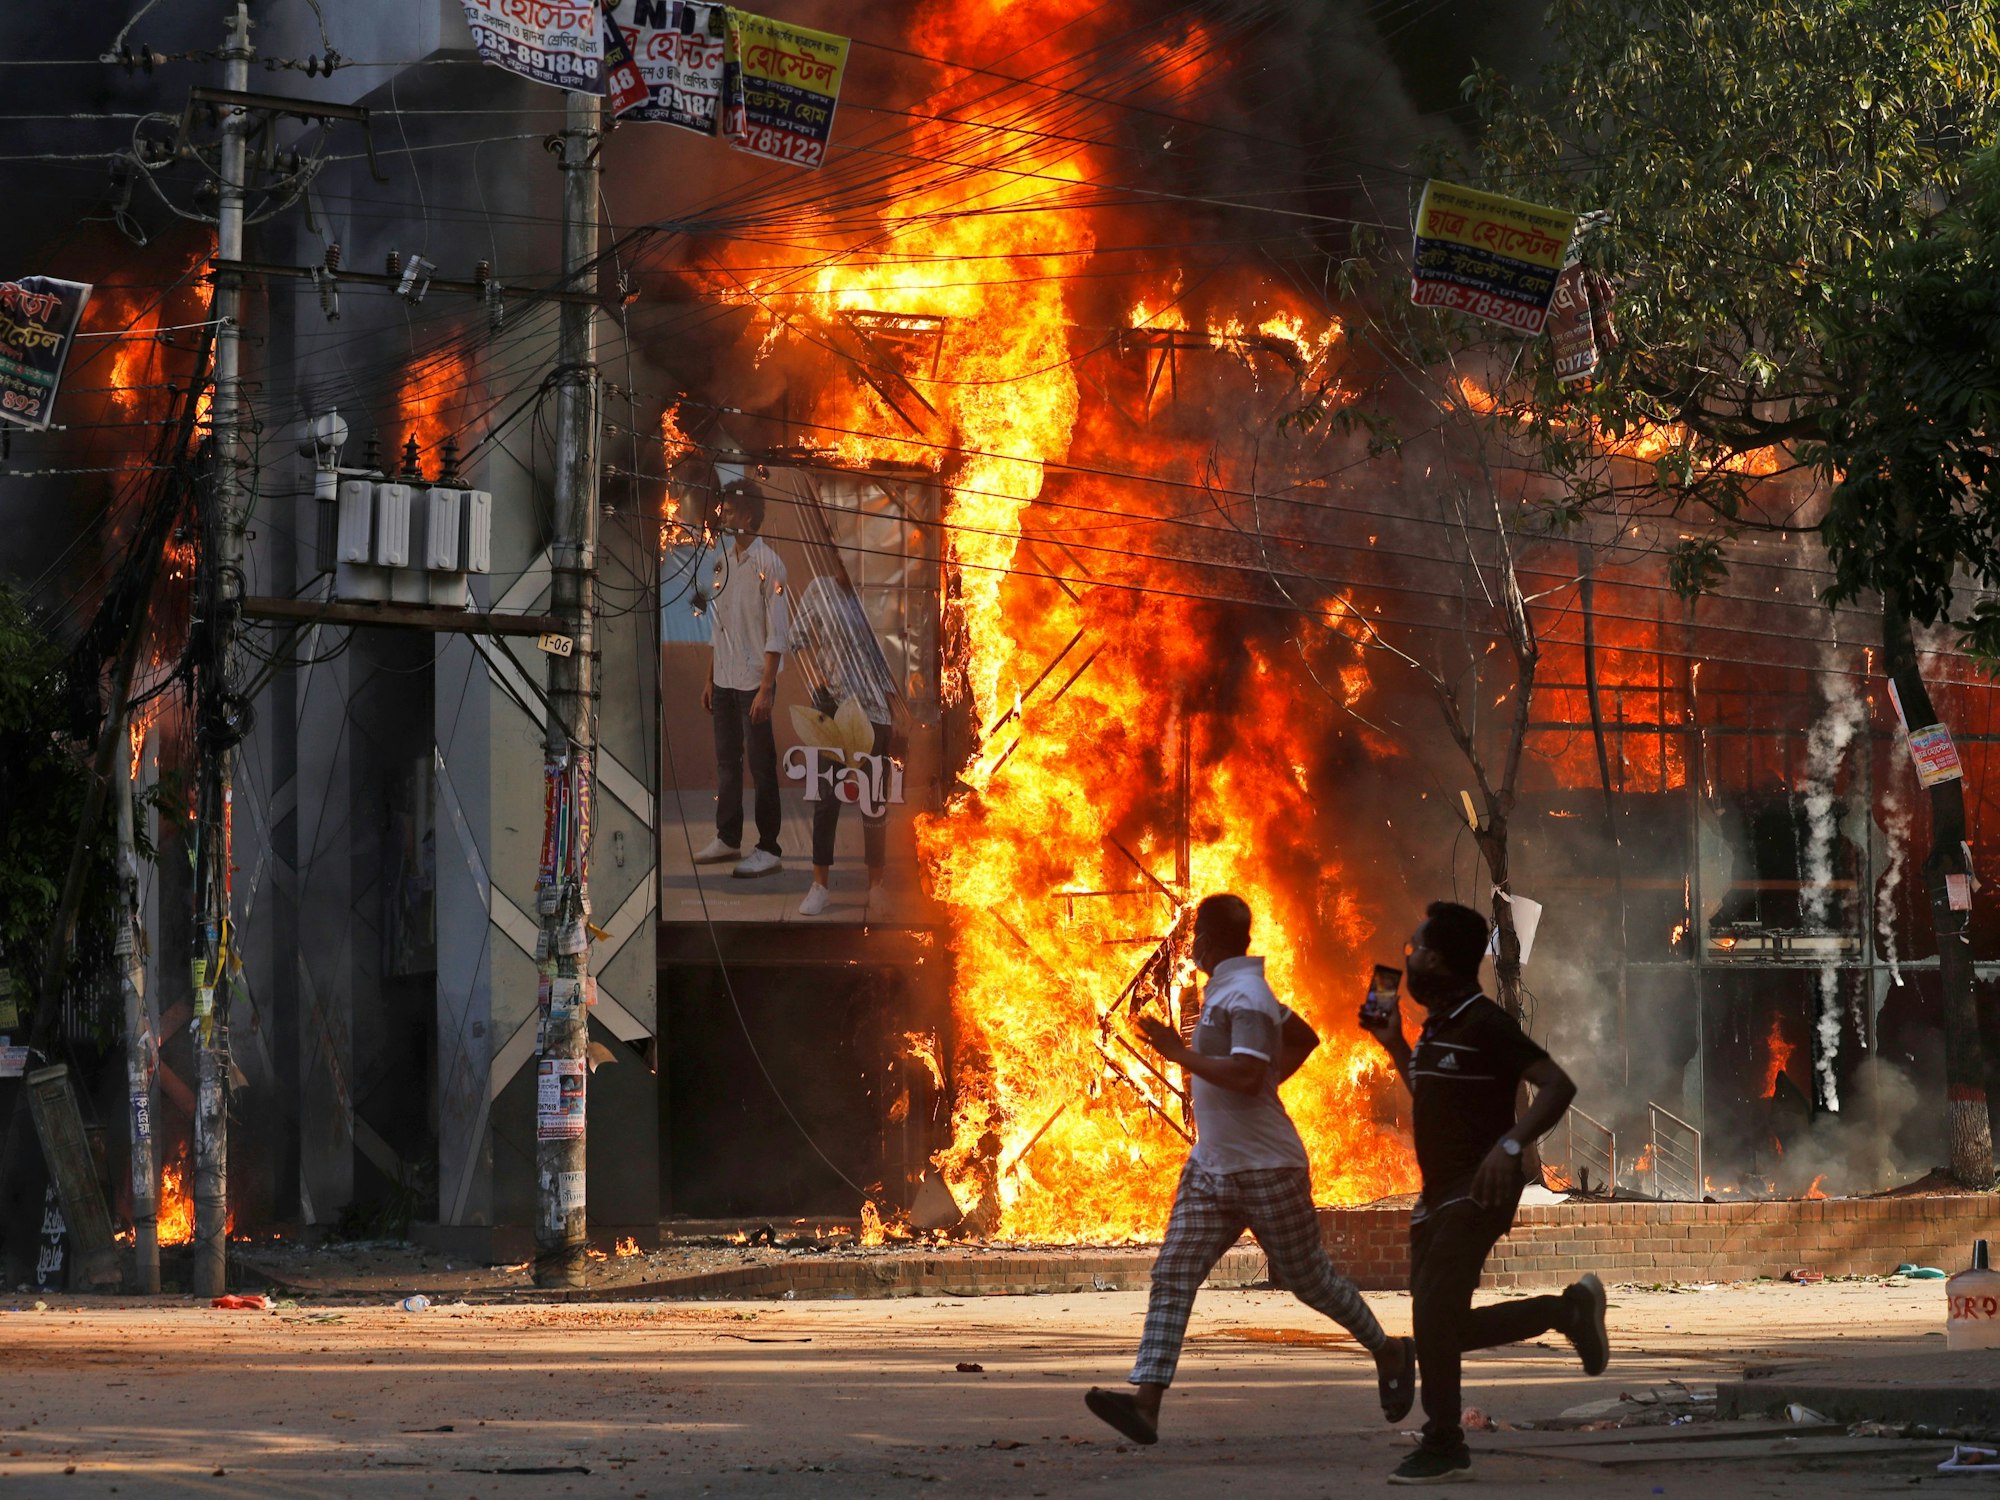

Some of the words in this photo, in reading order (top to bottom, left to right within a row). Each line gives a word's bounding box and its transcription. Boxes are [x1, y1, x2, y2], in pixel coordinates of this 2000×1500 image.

[482, 13, 511, 33] একাদশ
[512, 24, 521, 37] ও
[523, 28, 545, 46] দ্বাদশ
[547, 32, 578, 48] শ্রেণির
[747, 44, 838, 91] হোস্টেল
[795, 103, 829, 125] হোম
[776, 117, 819, 137] ঢাকা
[1428, 209, 1469, 240] ছাত্র
[1472, 223, 1565, 264] হোস্টেল
[1501, 287, 1541, 305] ঢাকা
[1518, 275, 1552, 293] হোম
[2, 390, 40, 417] 892
[544, 634, 571, 653] T-06
[782, 745, 906, 818] Fall
